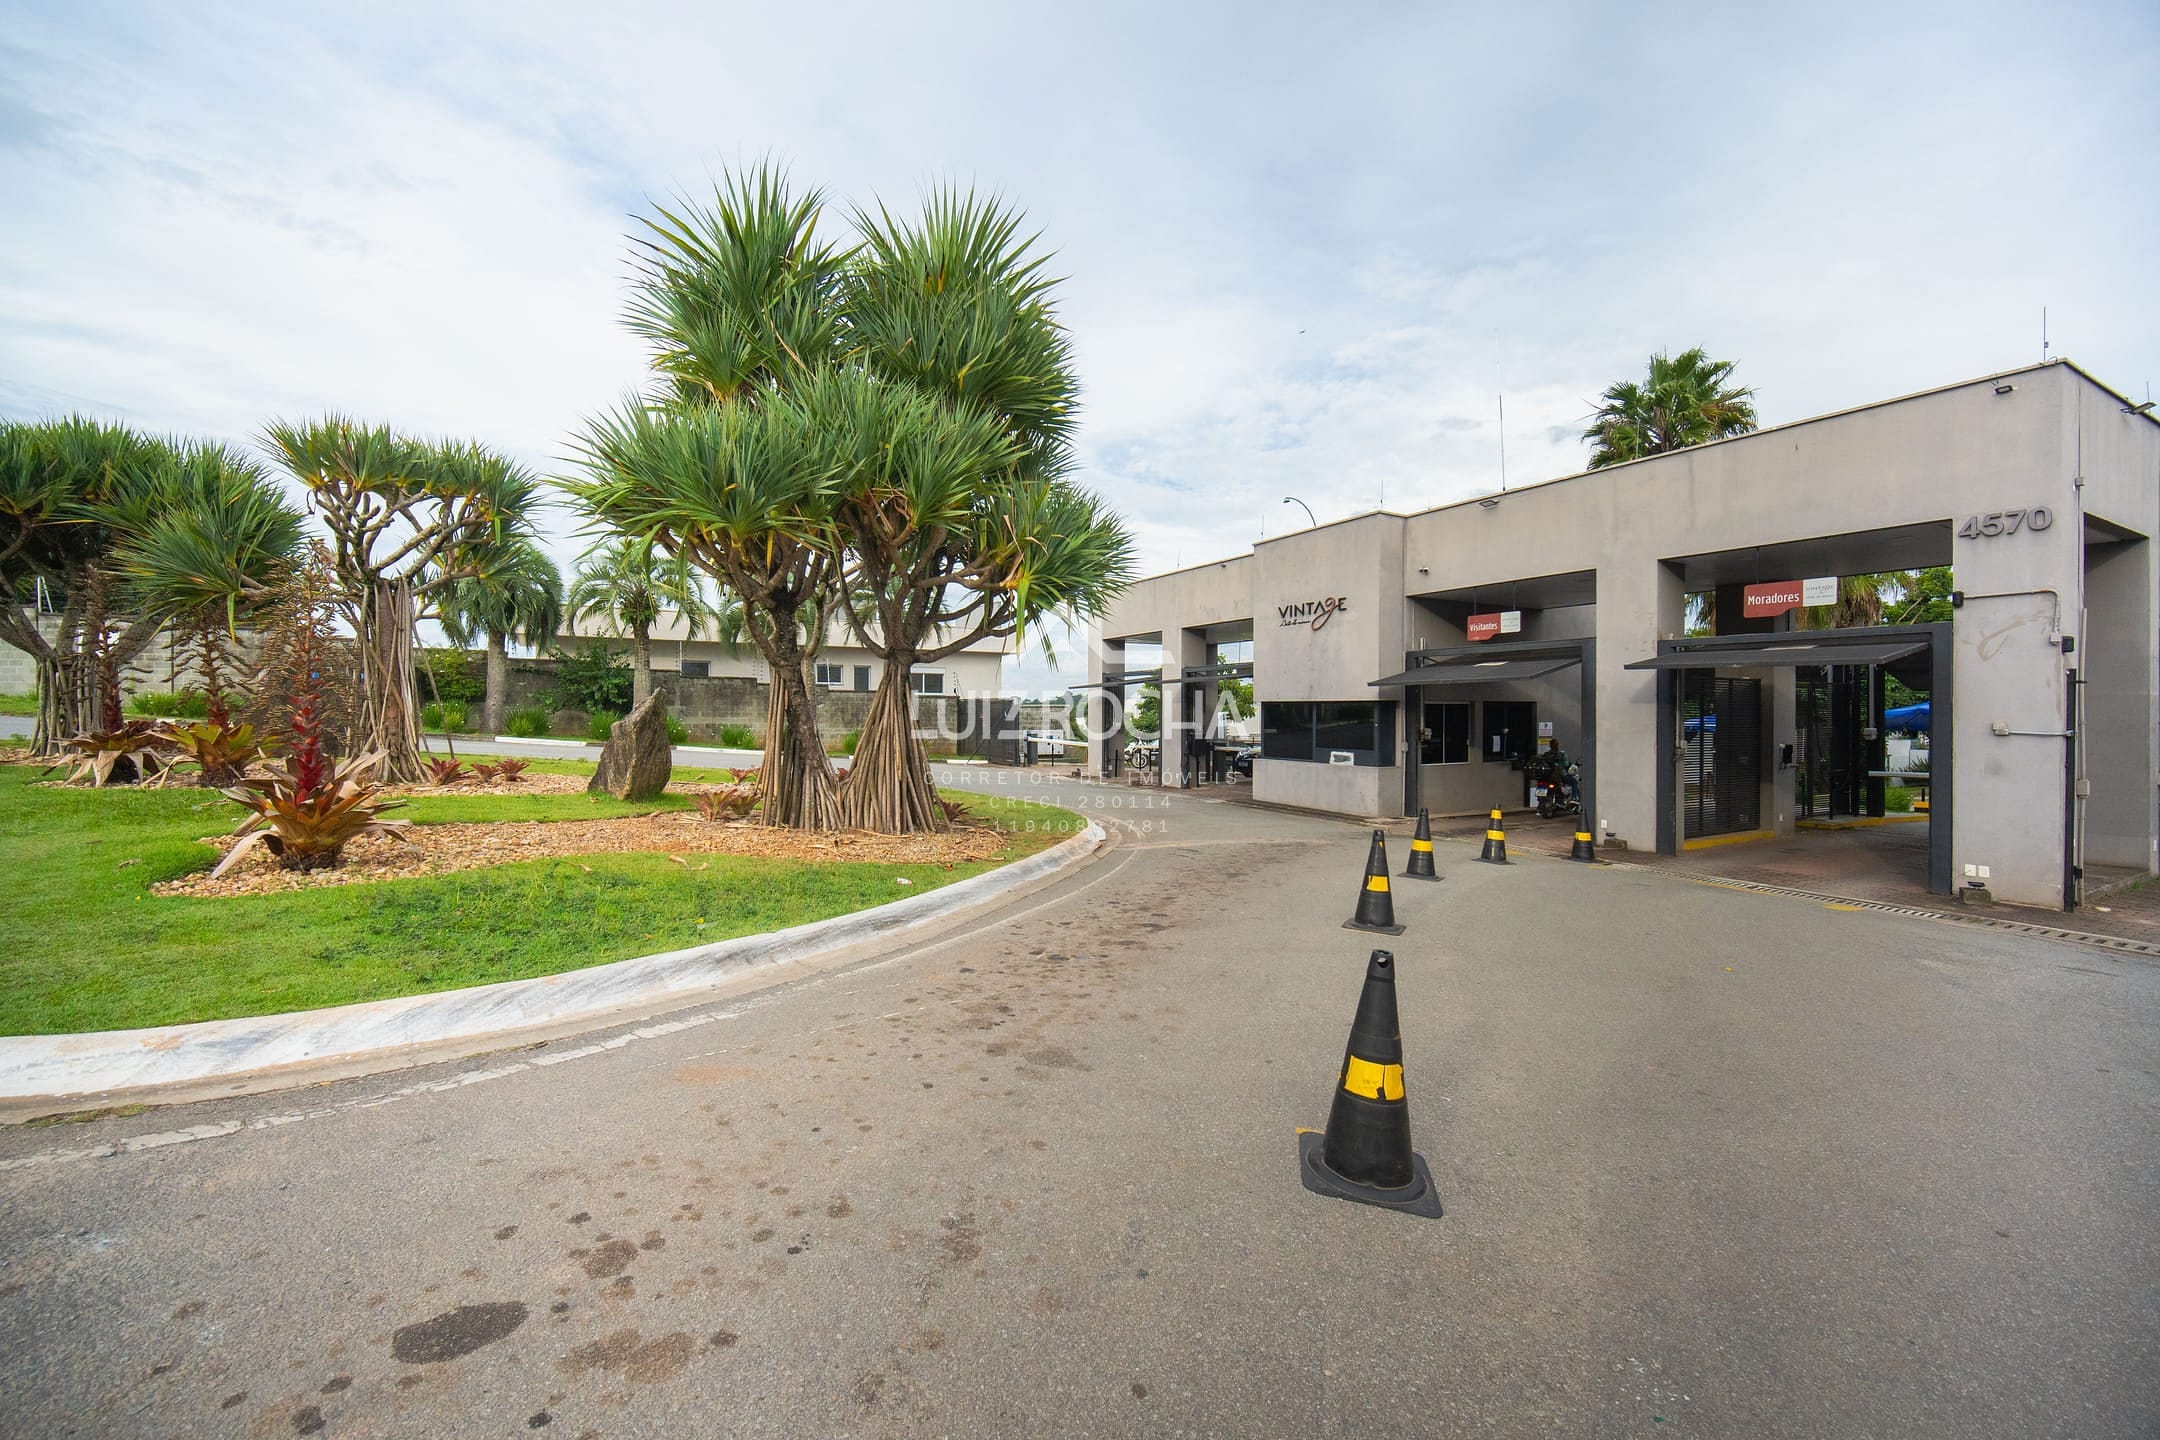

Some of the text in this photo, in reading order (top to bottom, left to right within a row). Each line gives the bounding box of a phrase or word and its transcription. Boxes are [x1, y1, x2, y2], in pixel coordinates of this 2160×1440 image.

[1958, 506, 2053, 539] 4570
[1747, 592, 1800, 606] Moradores
[1469, 622, 1498, 632] Visitantes
